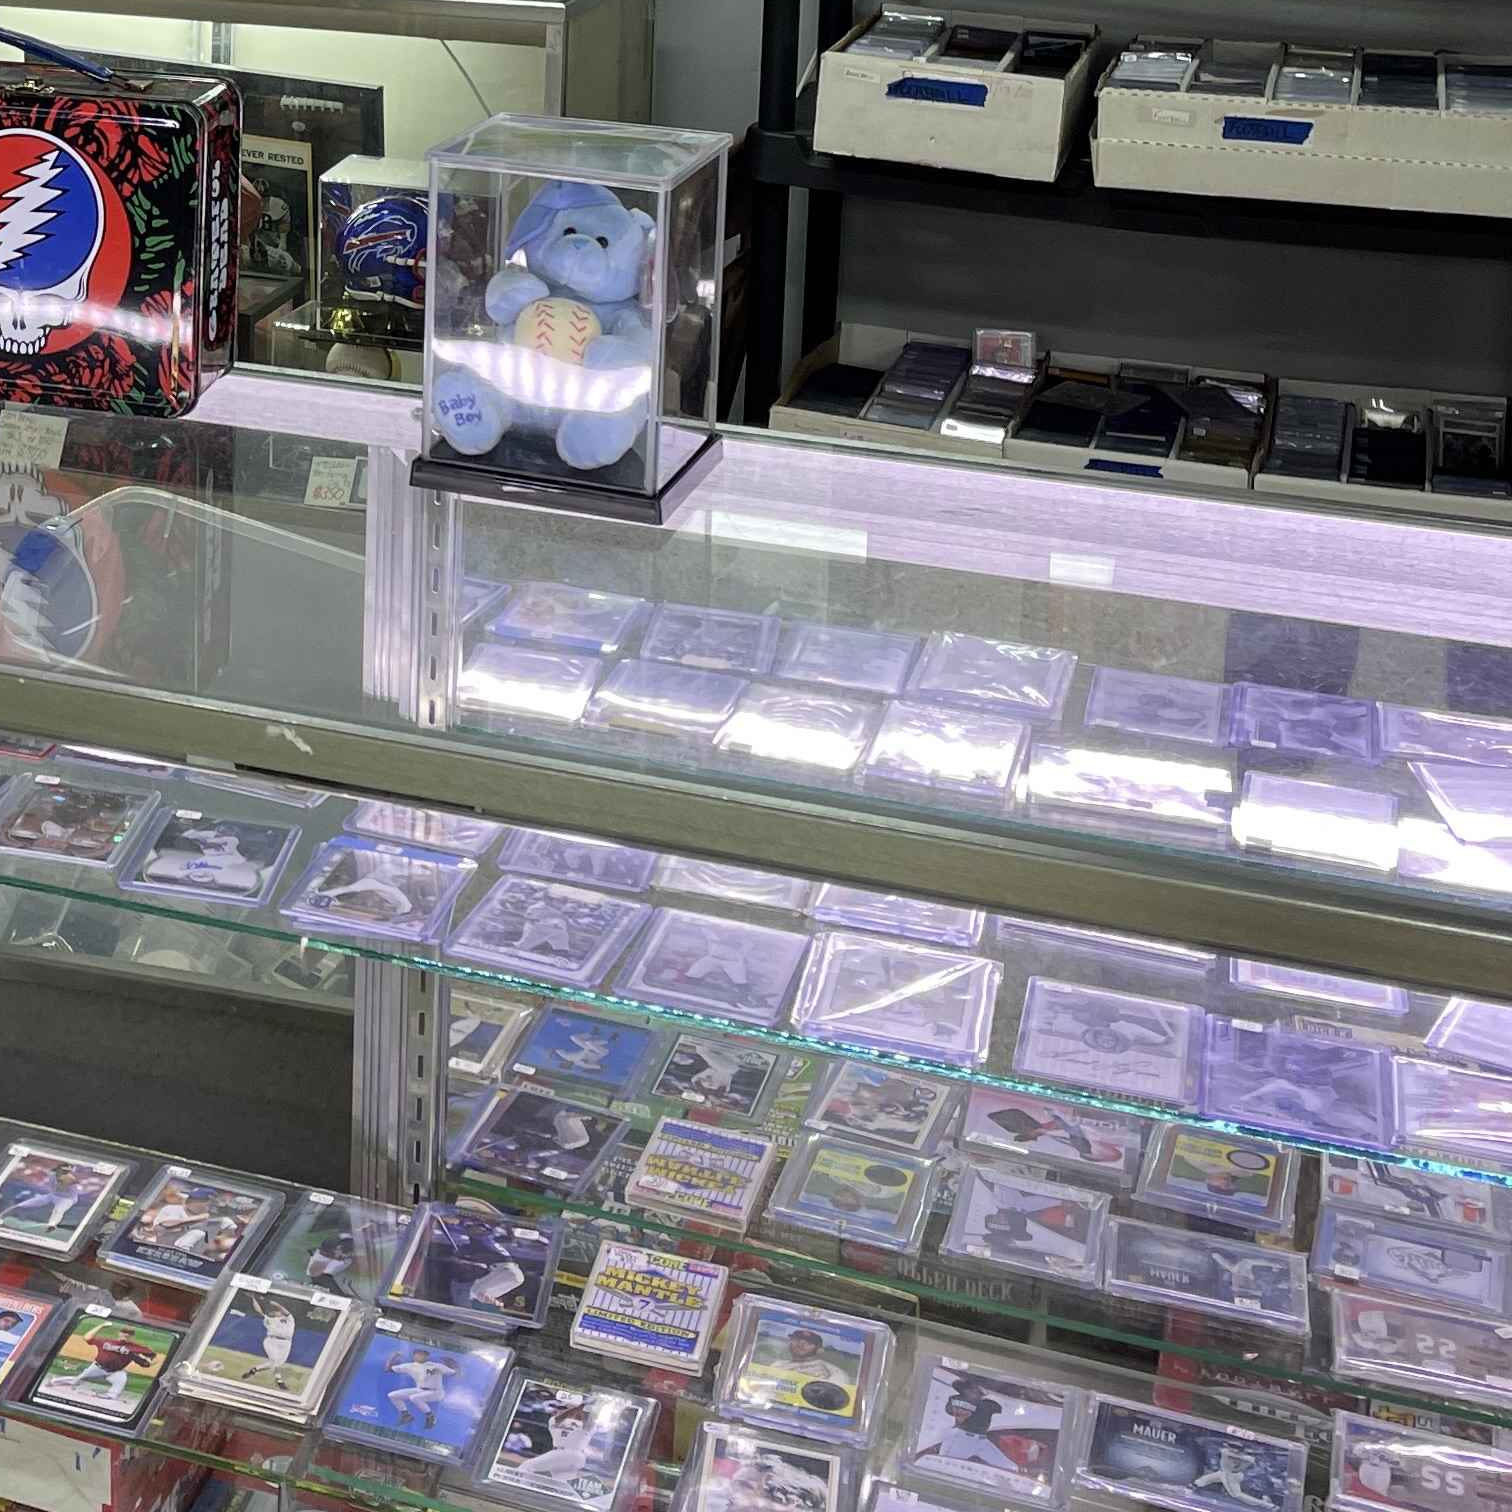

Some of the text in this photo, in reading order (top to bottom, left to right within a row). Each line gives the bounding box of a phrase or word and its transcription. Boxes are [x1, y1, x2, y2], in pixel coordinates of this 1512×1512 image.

[267, 152, 305, 166] RESTED
[438, 393, 476, 416] Baby
[454, 410, 482, 427] Boy
[605, 1265, 703, 1297] MICKEY
[595, 1274, 704, 1309] MANTLE
[637, 1298, 651, 1311] 7
[640, 1321, 691, 1339] EDITION
[1132, 1423, 1178, 1445] MAUER
